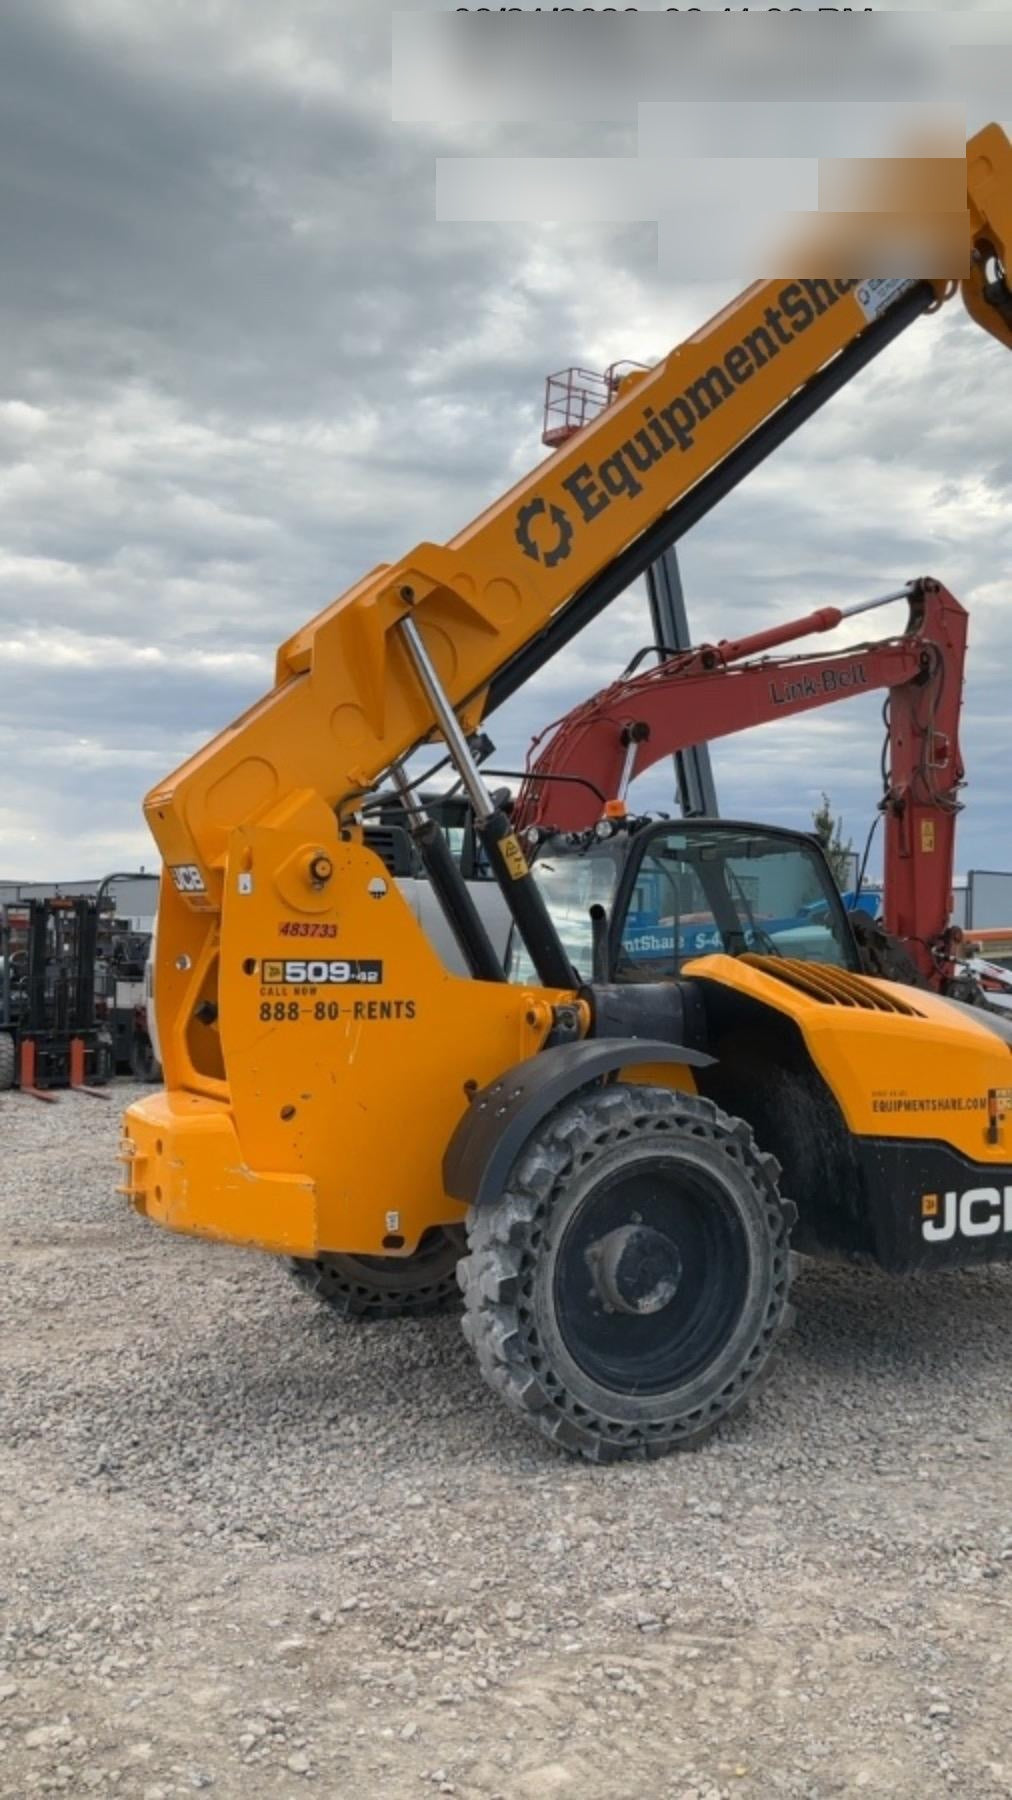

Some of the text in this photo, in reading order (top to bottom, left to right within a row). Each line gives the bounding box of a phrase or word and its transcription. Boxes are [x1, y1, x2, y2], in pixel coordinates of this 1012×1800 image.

[279, 922, 338, 938] 483733
[259, 987, 317, 996] CALL NOW
[872, 1098, 986, 1113] EQUIPMENTSHARE.COM
